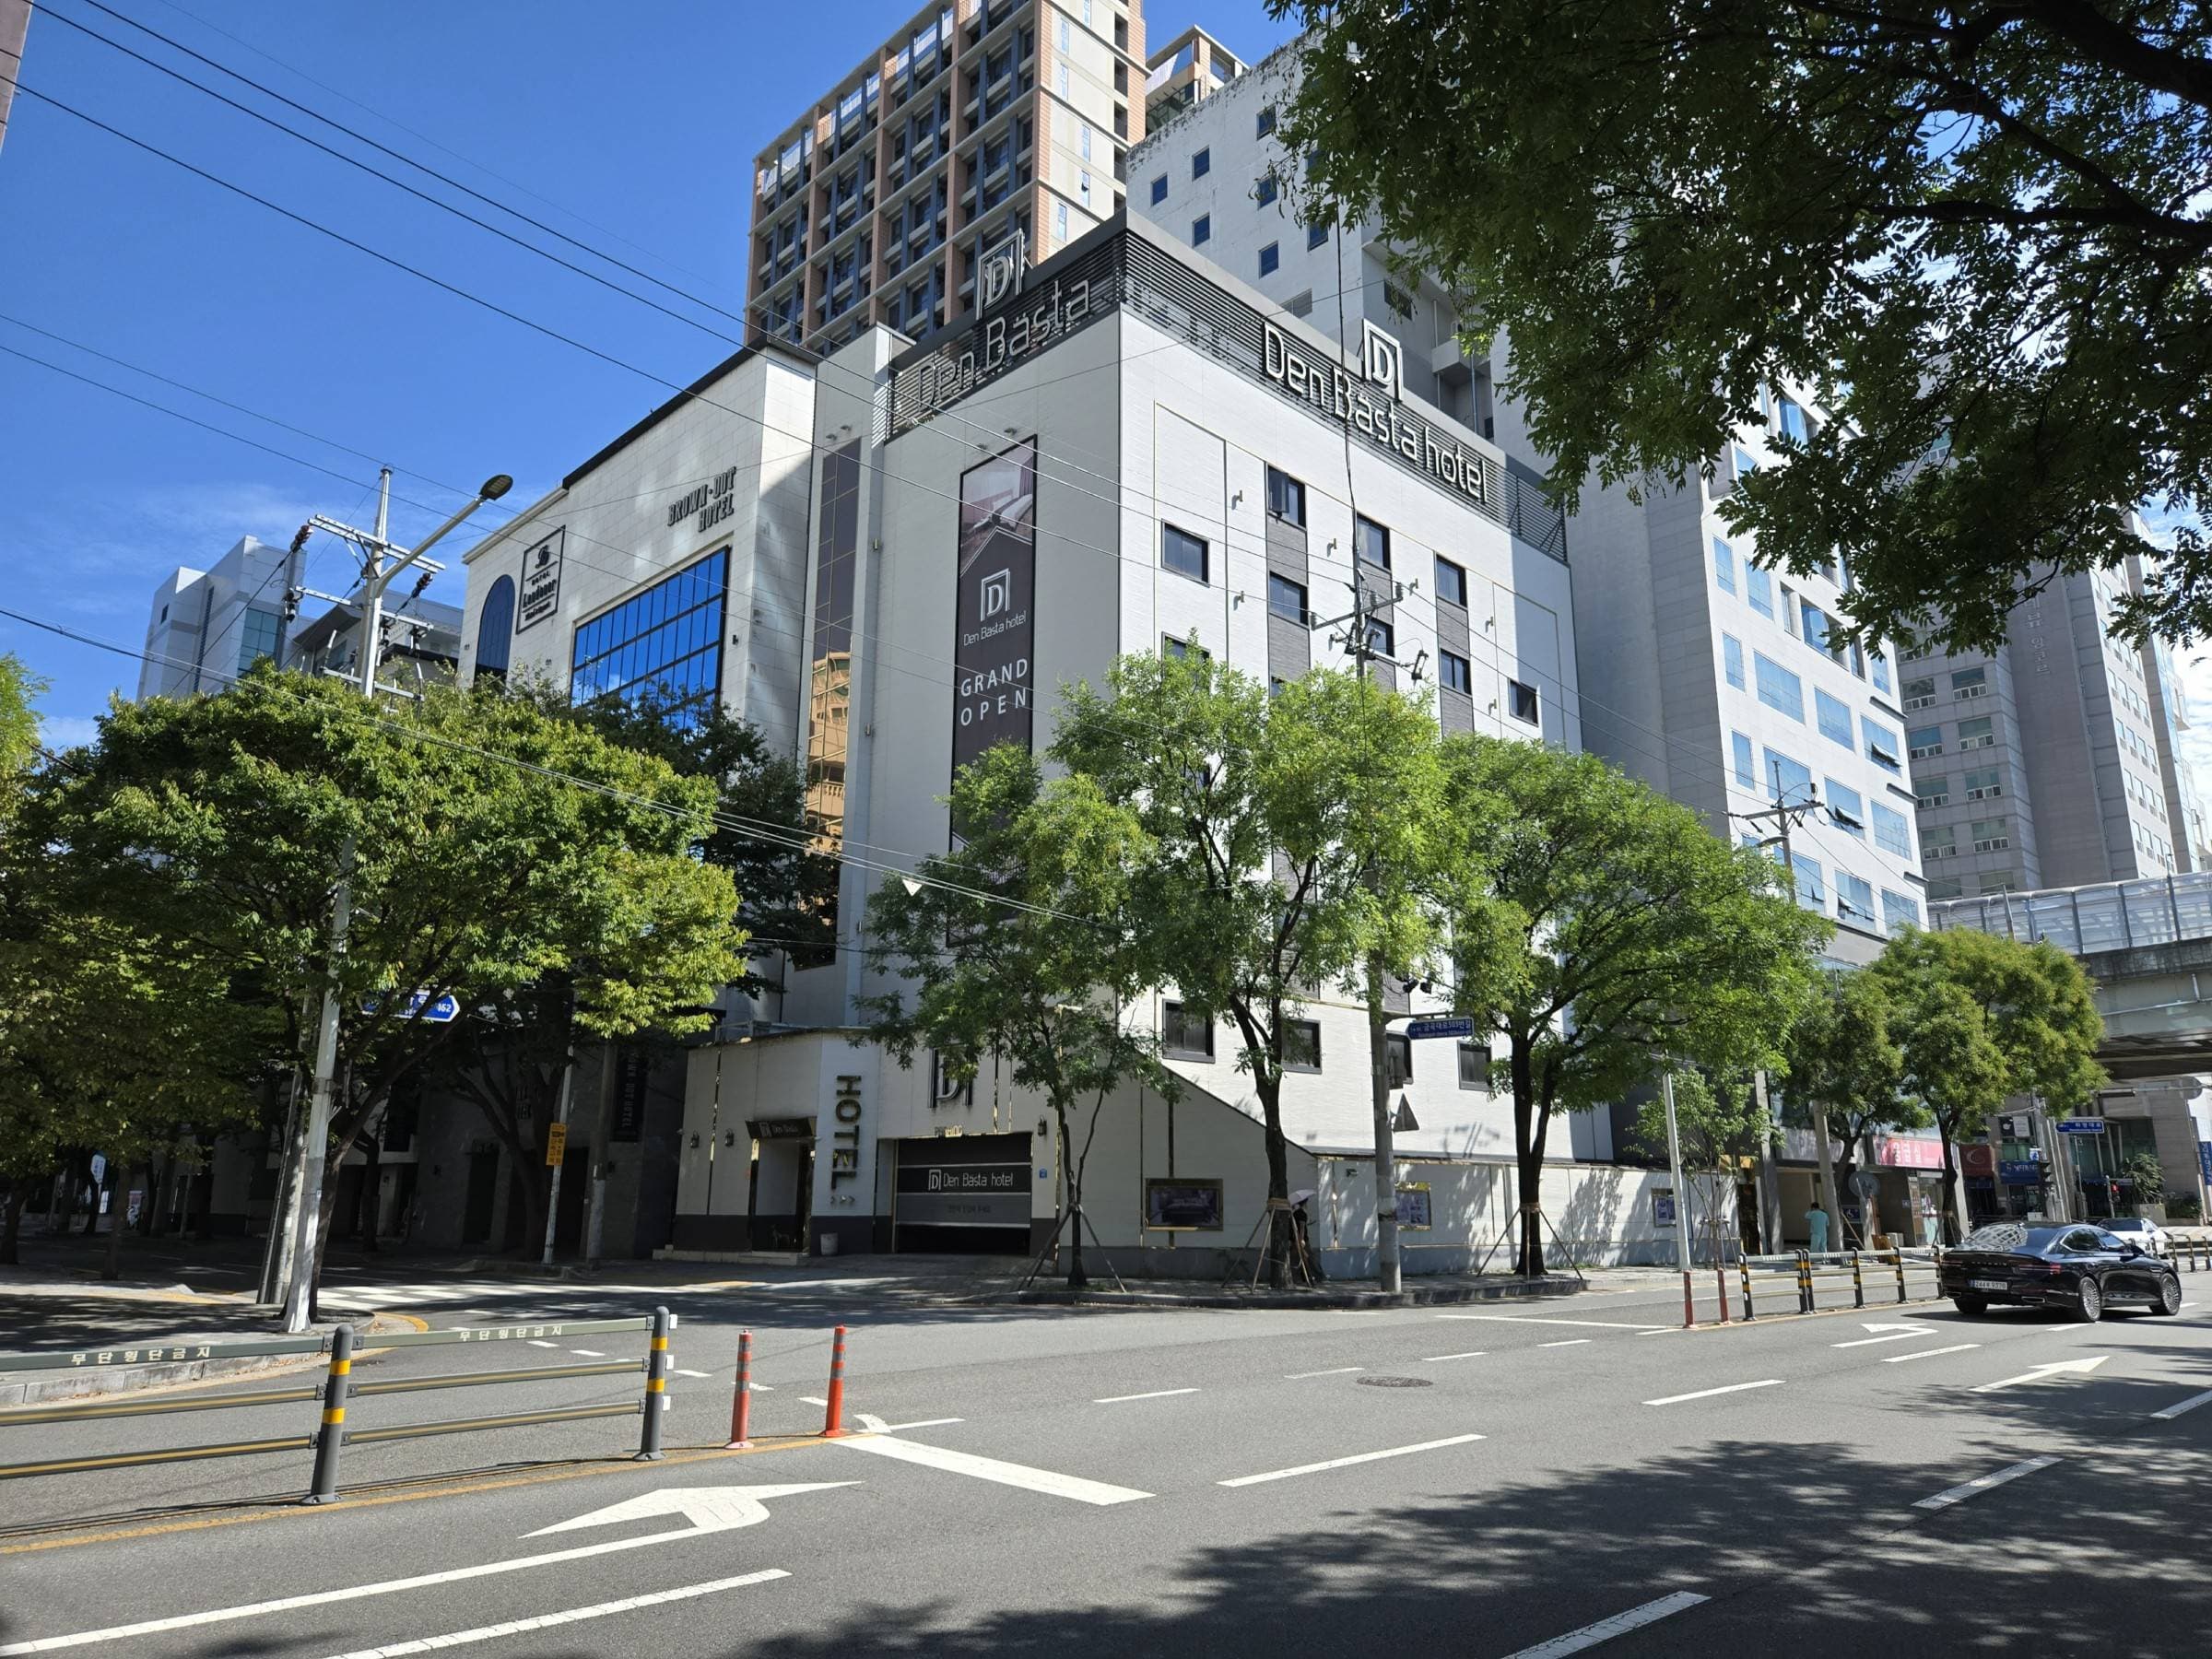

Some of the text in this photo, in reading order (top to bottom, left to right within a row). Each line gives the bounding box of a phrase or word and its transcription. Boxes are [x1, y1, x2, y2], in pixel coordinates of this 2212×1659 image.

[917, 351, 975, 413] Den
[1265, 323, 1488, 503] Den Bästa hotel
[699, 493, 735, 533] HOTEL
[963, 632, 979, 646] Den
[1006, 611, 1027, 629] hotel
[2030, 633, 2052, 677] 앙코르
[960, 658, 1029, 697] GRAND
[960, 688, 1027, 726] OPEN
[830, 1075, 862, 1191] HOTEL
[943, 1172, 959, 1187] Den
[991, 1171, 1014, 1187] hotel
[457, 1325, 562, 1341] 무단횡단금지
[71, 1347, 210, 1366] 무단횡단금지
